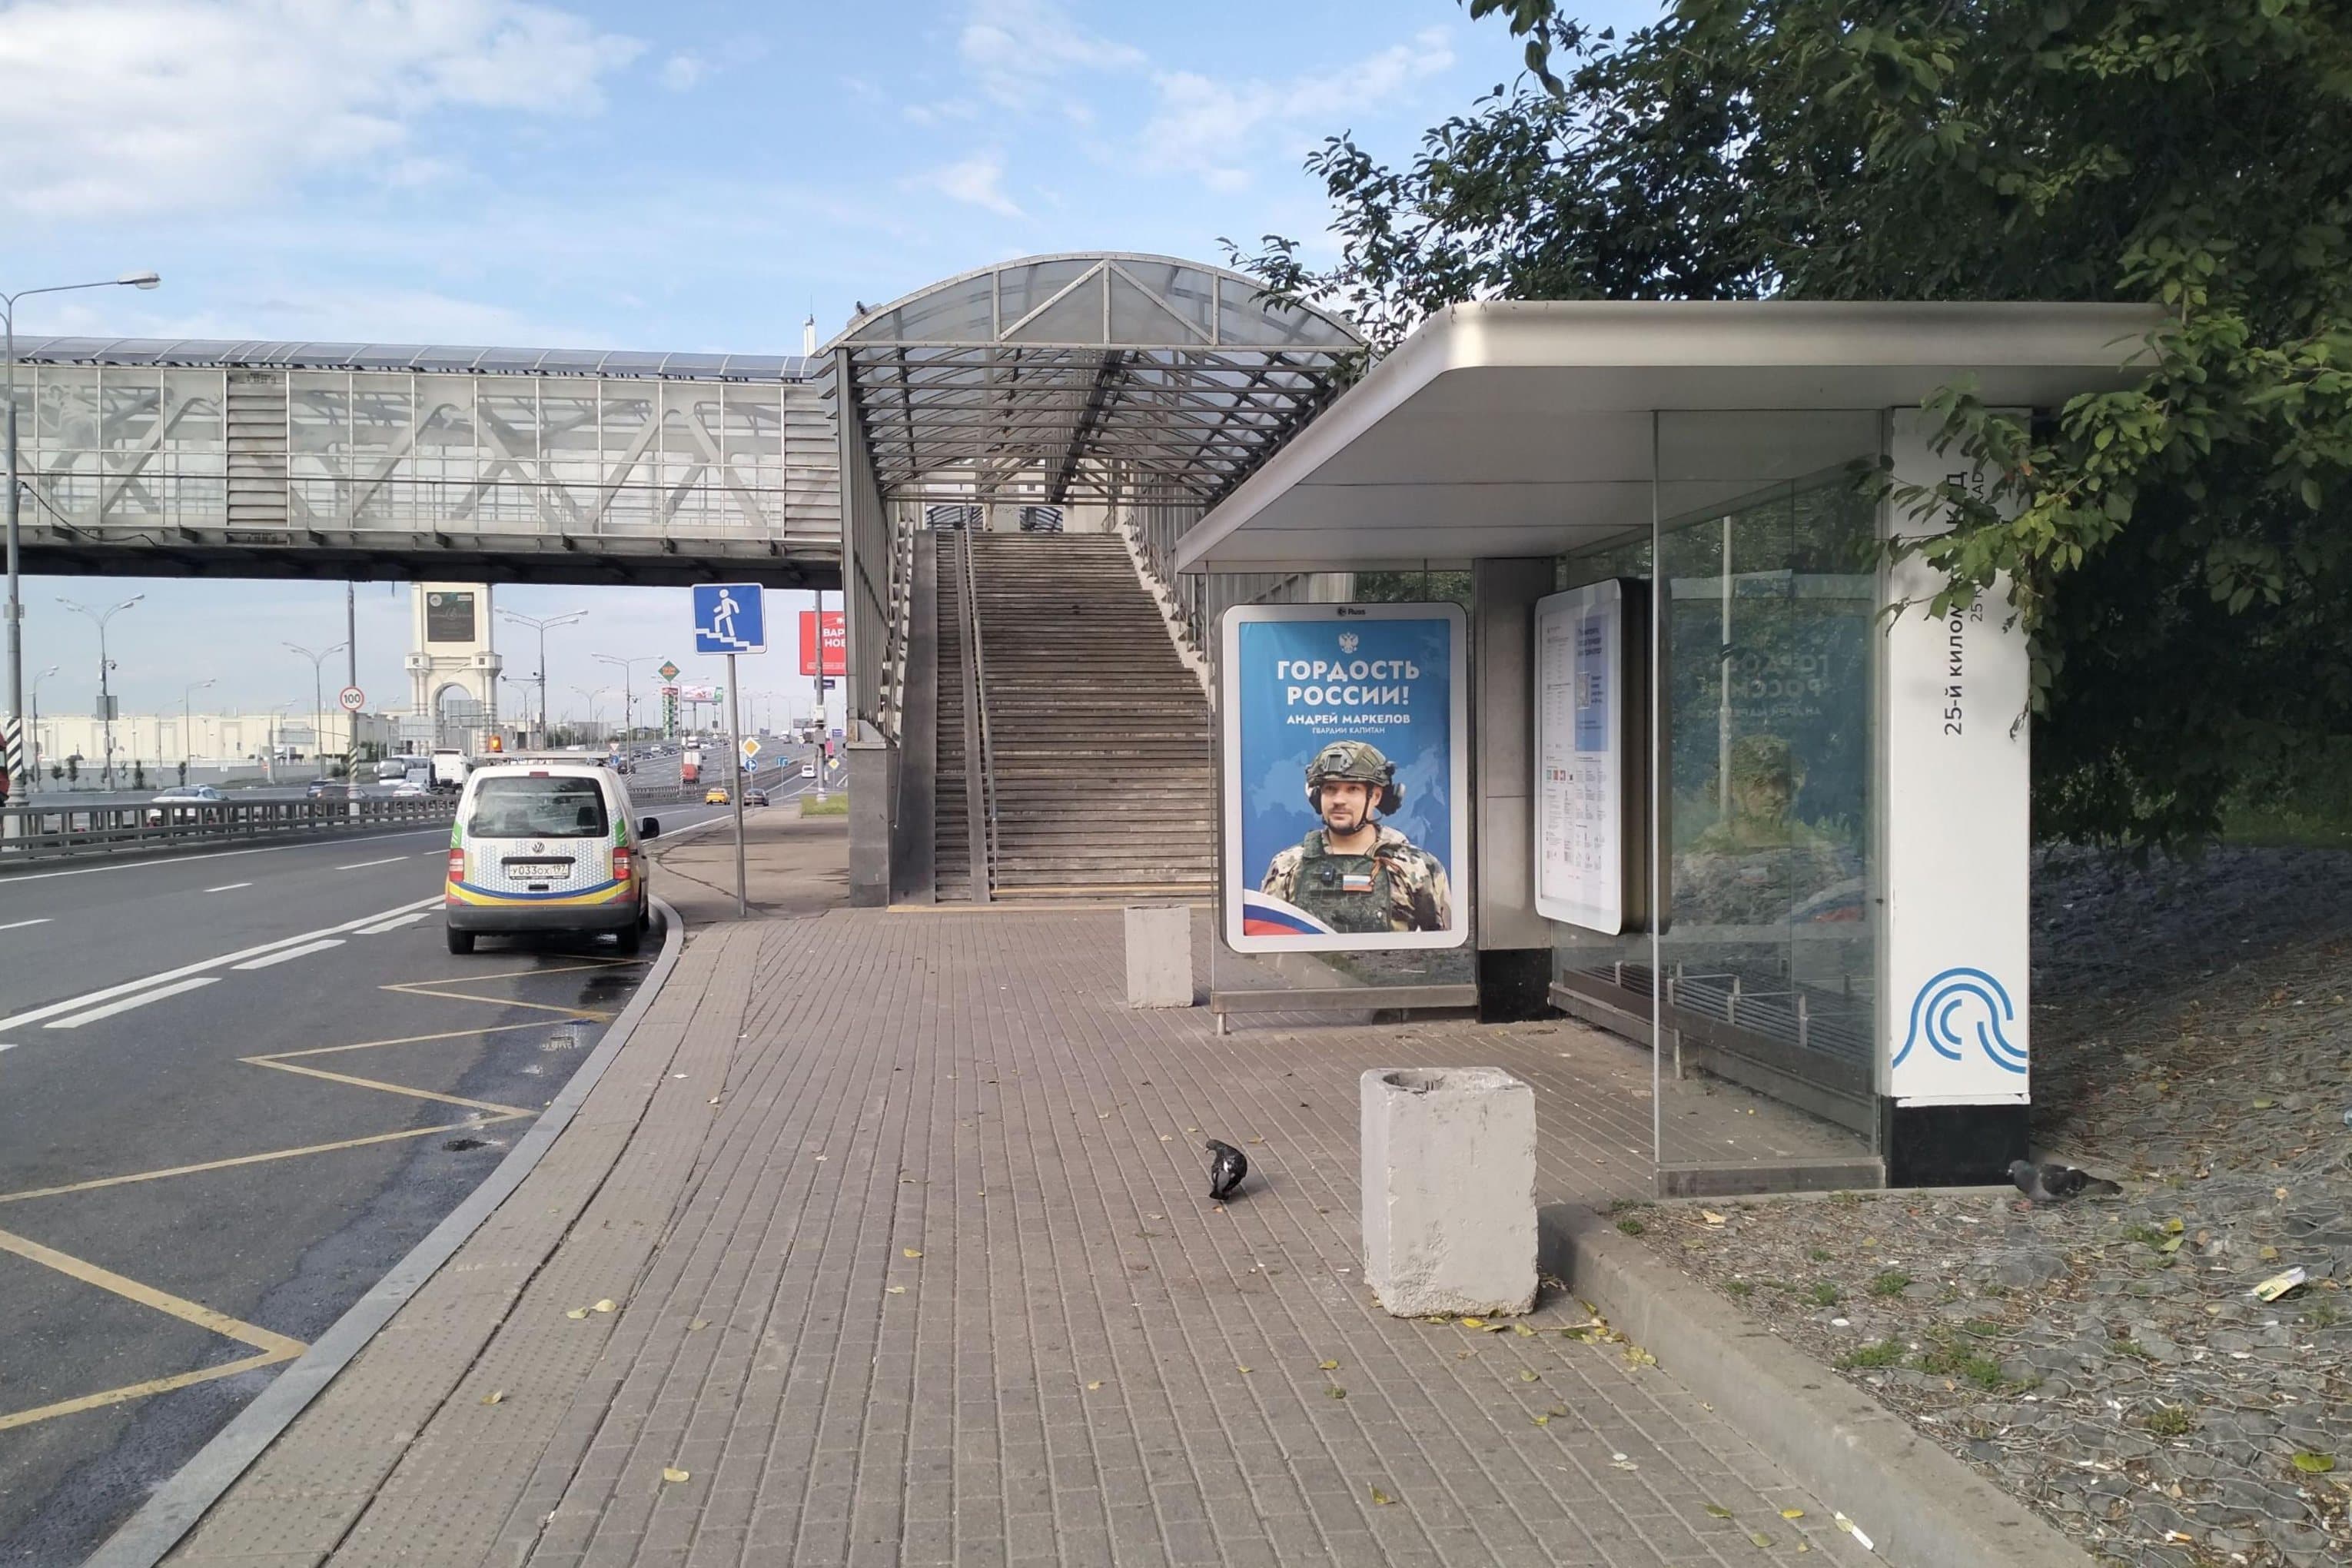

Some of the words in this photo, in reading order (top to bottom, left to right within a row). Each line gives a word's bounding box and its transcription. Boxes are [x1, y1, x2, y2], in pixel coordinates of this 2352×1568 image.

[1971, 603, 1982, 622] 25
[1950, 581, 1963, 676] килом
[1277, 660, 1420, 683] ГОРДОСТЬ
[344, 693, 360, 703] 100
[1287, 686, 1410, 706] РОССИИ!
[1287, 713, 1338, 725] АНДРЕЙ
[1342, 714, 1410, 724] МАРКЕЛОВ
[1945, 685, 1962, 736] 25-й
